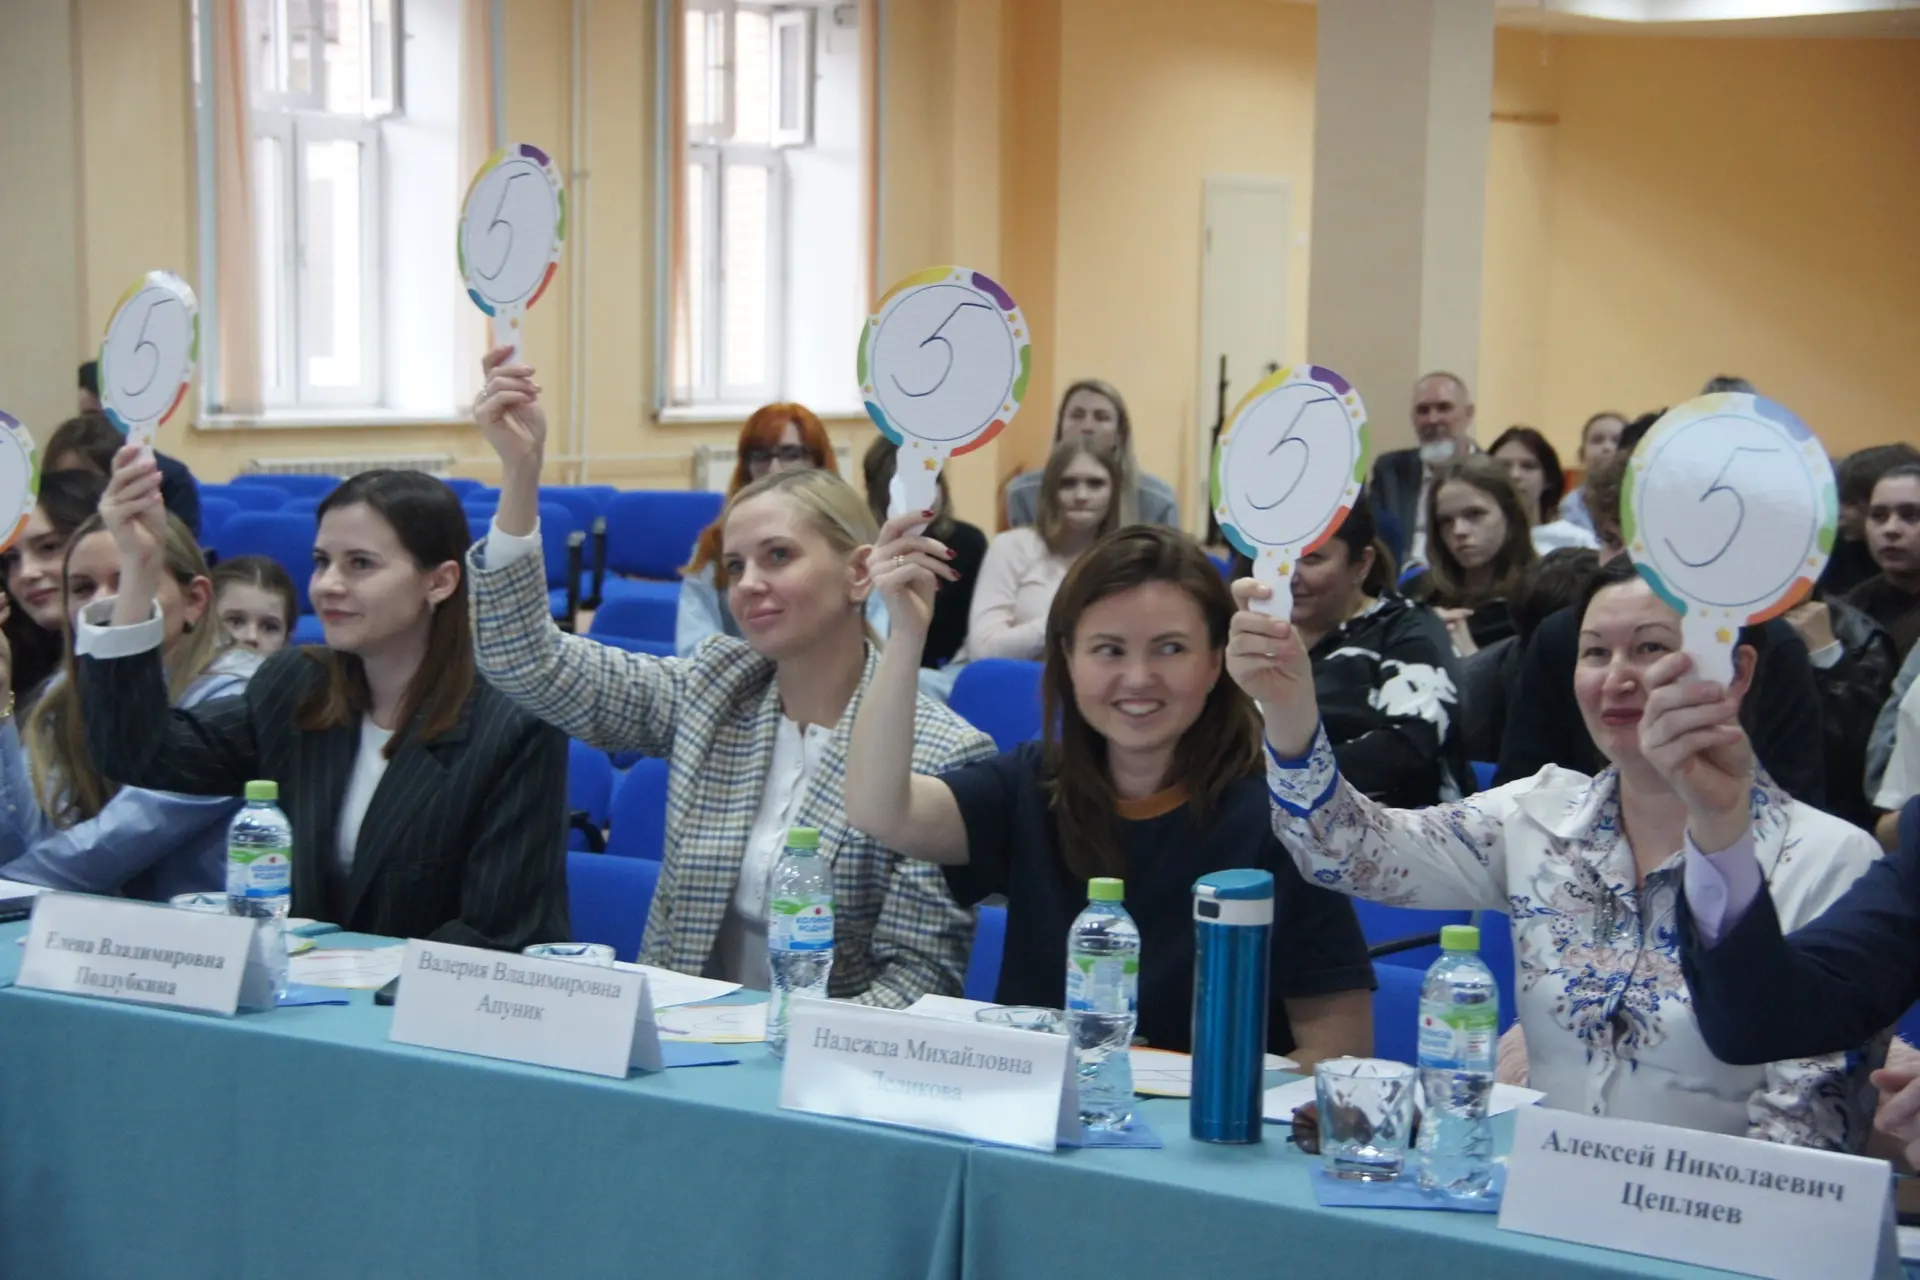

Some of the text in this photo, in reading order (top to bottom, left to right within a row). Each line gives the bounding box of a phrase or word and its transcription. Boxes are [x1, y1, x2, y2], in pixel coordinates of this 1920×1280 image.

[474, 172, 532, 281] 5
[121, 298, 176, 397] 5
[889, 301, 993, 397] 5
[1244, 396, 1338, 510] 5
[1663, 446, 1781, 567] 5
[45, 930, 226, 970] Елена Владимировна
[417, 950, 489, 980] Валерия
[492, 961, 622, 999] Владимировна
[475, 993, 545, 1021] Апуник
[812, 1027, 1034, 1075] Надежда Михайловна
[1540, 1129, 1846, 1202] Алексей Николаевич
[1620, 1181, 1743, 1225] Цепляев
